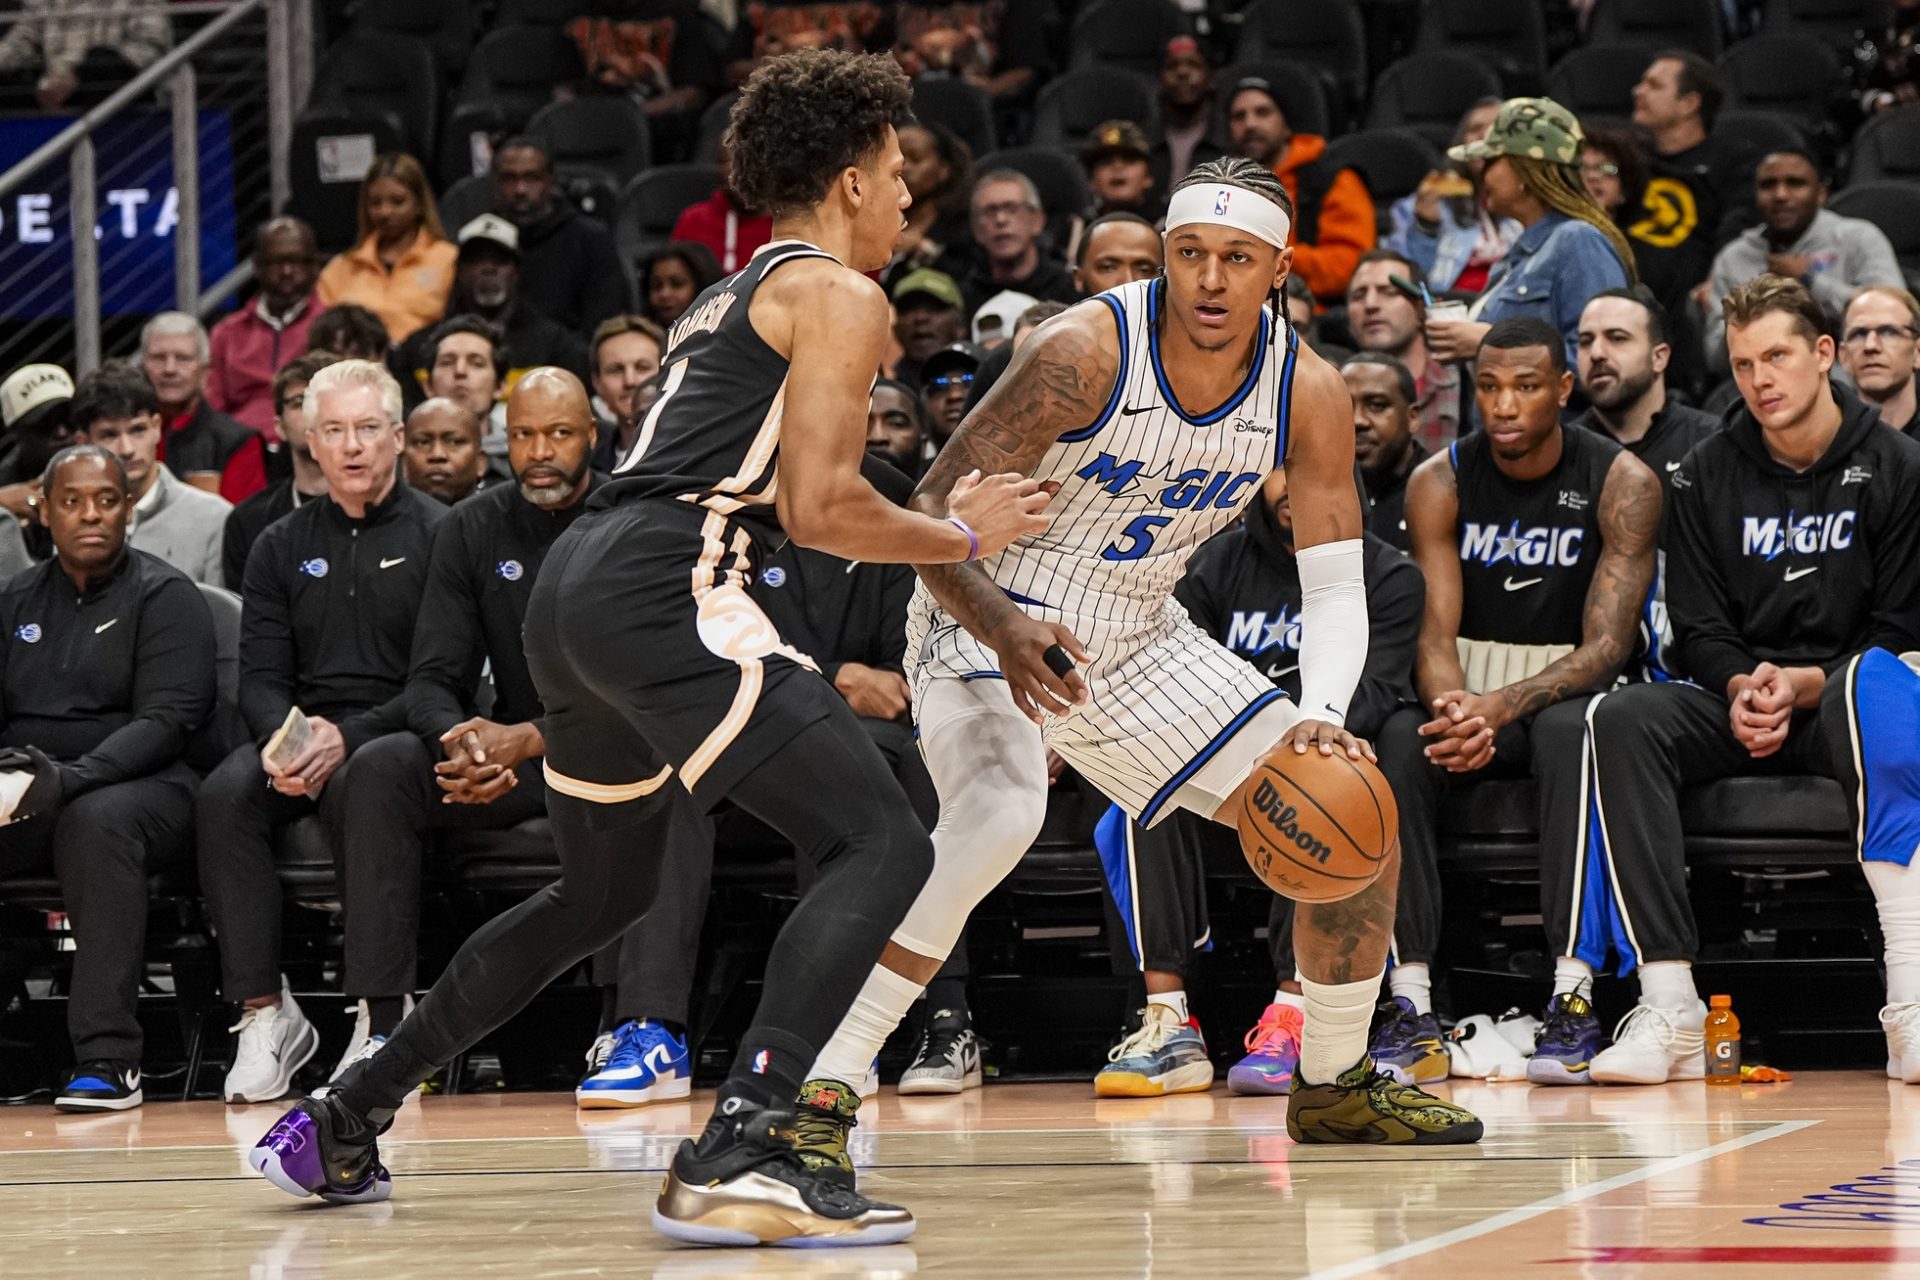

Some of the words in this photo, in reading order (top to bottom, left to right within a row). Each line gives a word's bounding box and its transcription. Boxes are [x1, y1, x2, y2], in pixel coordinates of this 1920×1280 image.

[0, 186, 180, 243] ETA
[611, 356, 689, 474] 1
[1100, 514, 1175, 561] 5
[1252, 776, 1332, 865] Wilson
[1716, 1041, 1731, 1059] G
